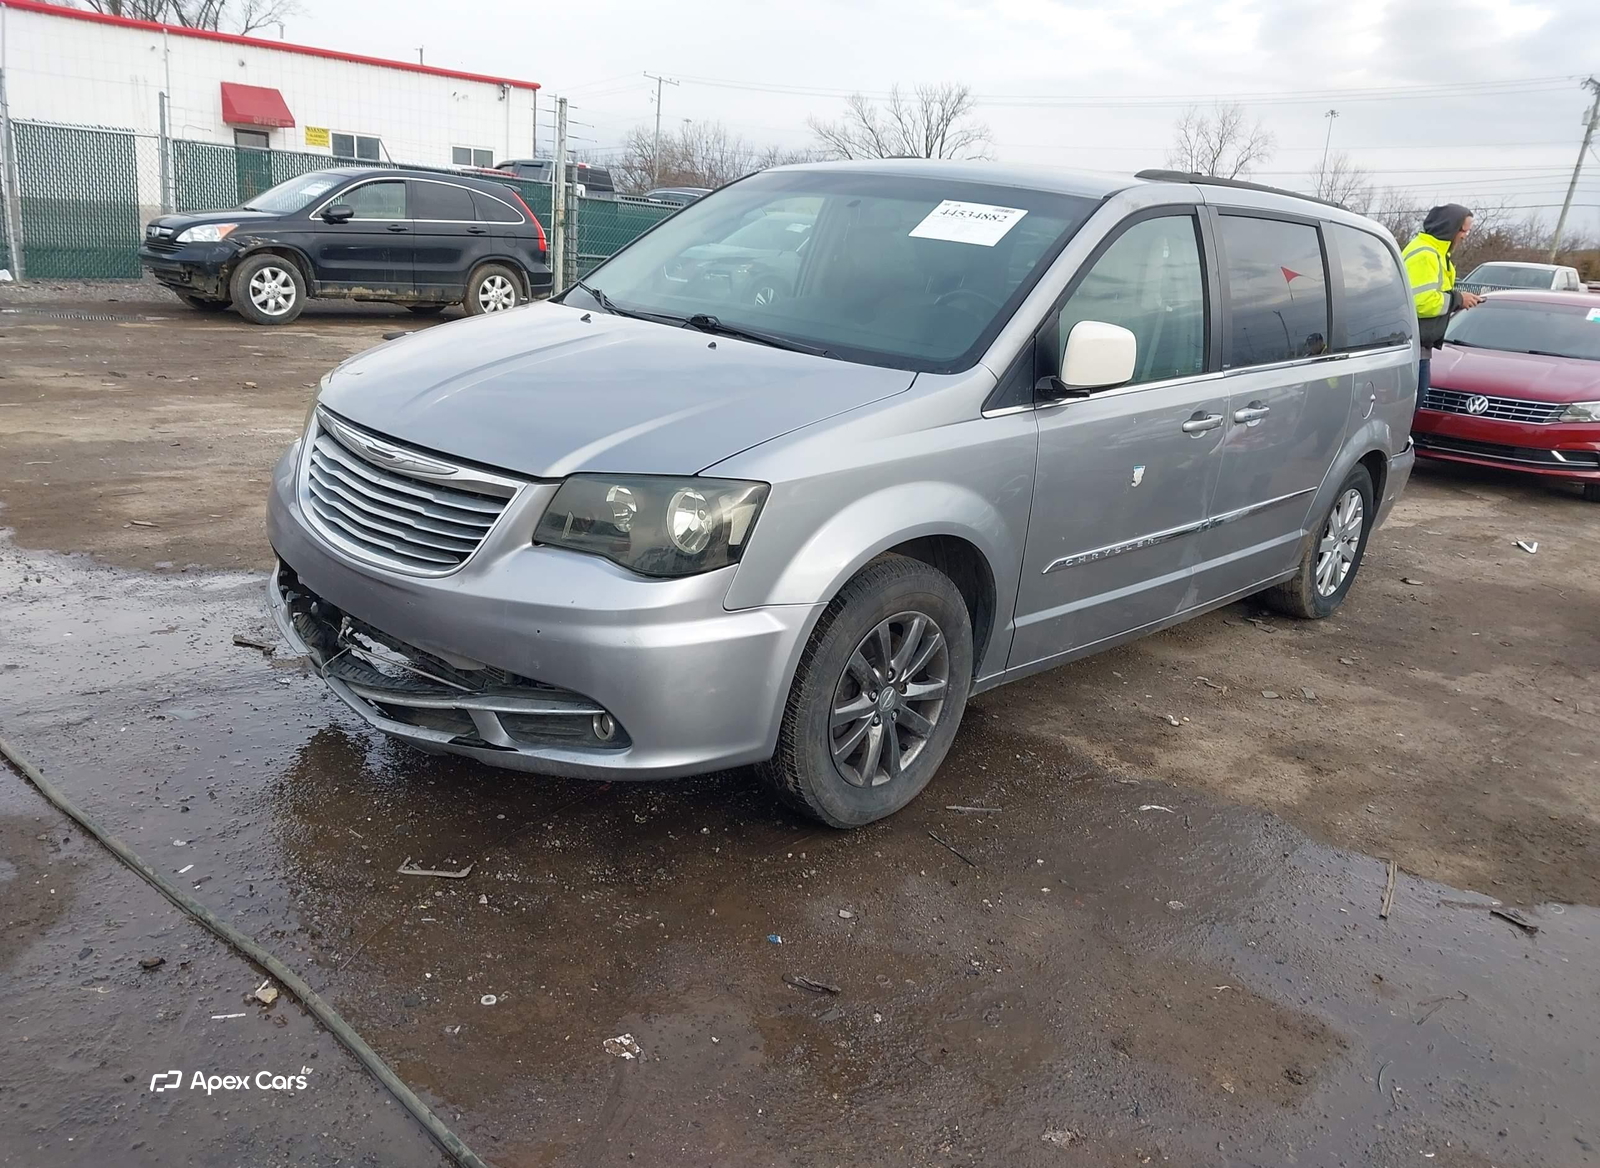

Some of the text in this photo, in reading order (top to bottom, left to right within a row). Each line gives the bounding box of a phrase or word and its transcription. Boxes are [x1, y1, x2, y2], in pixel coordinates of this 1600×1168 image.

[253, 116, 279, 126] OFFICE
[940, 209, 1008, 222] 44534882
[1065, 538, 1154, 566] CHRYSLER
